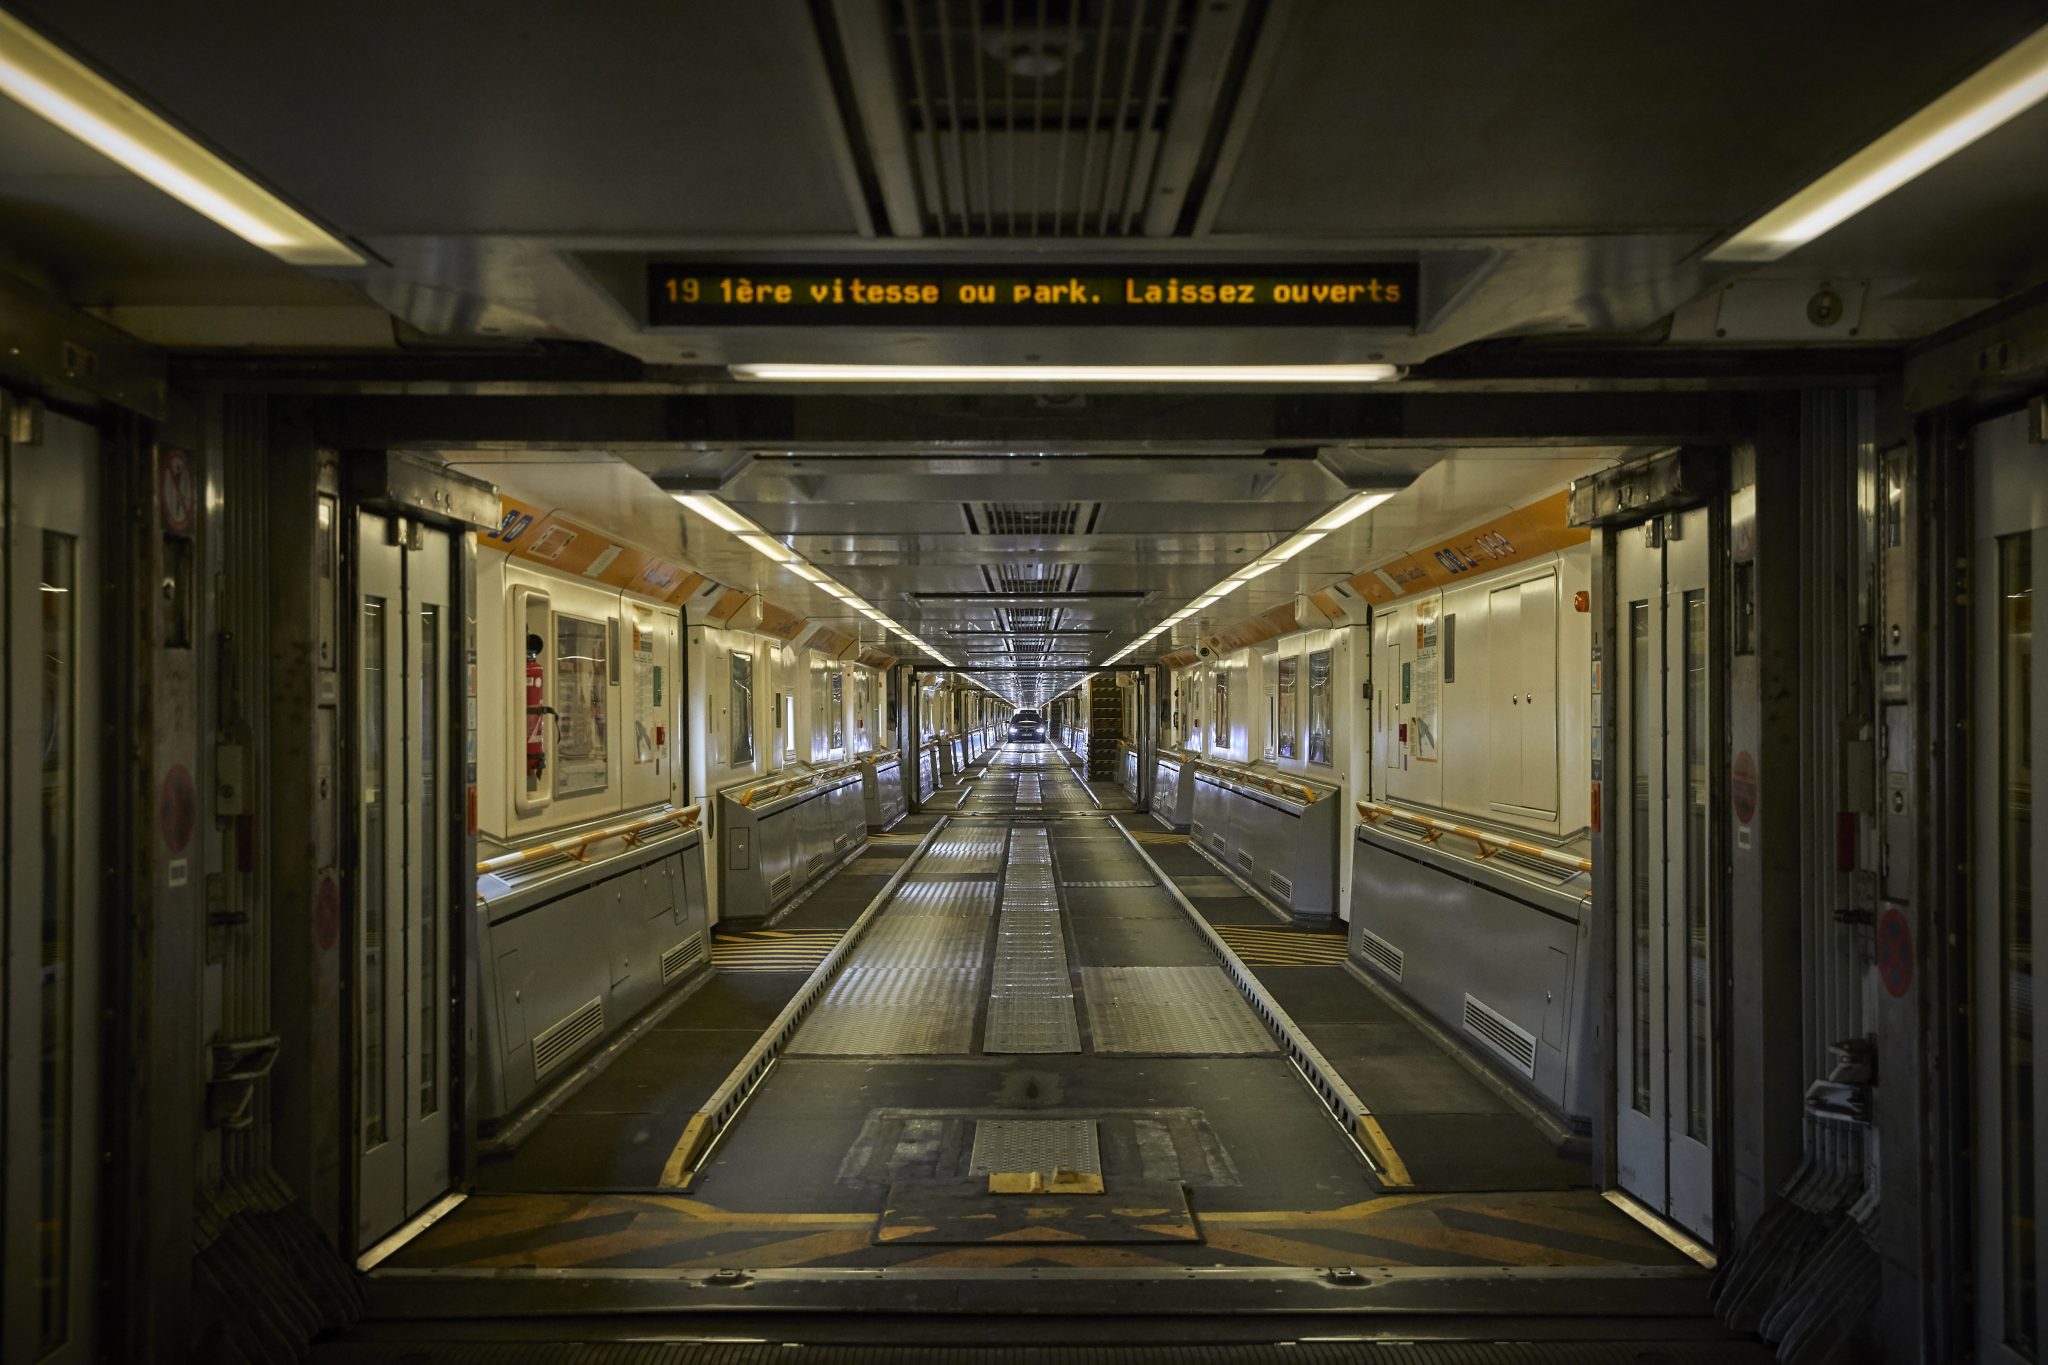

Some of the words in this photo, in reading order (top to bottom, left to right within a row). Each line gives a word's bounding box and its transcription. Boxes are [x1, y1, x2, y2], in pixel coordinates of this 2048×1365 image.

[666, 279, 701, 302] 19
[721, 278, 792, 302] 1ère
[811, 279, 940, 302] vitesse
[958, 285, 995, 302] ou
[1013, 279, 1099, 302] park.
[1126, 279, 1254, 302] Laissez
[1273, 280, 1401, 303] ouverts
